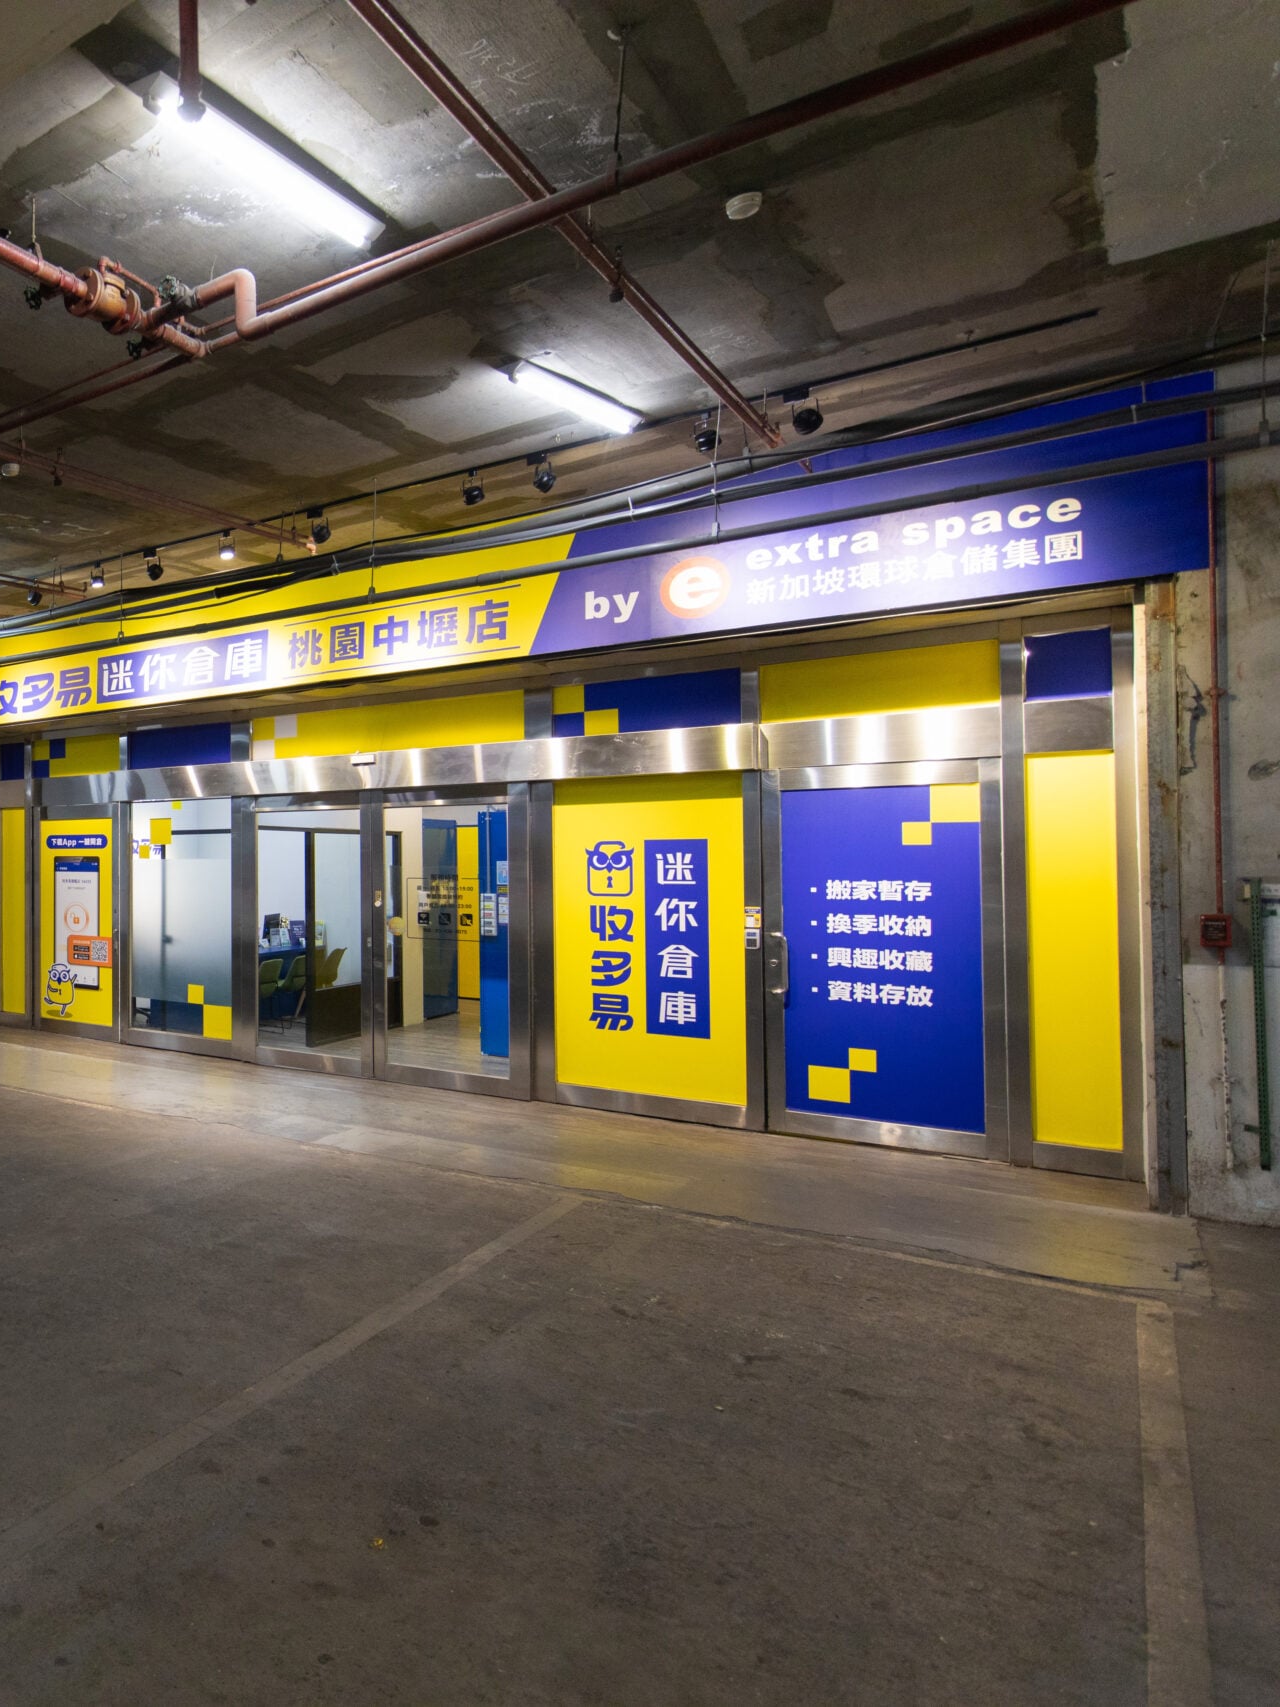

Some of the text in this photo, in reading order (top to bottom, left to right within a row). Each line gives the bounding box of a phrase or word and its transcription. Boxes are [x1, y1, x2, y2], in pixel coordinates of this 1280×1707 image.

[746, 498, 1082, 571] extra space
[745, 530, 1083, 604] 新加坡環球倉儲集團
[584, 591, 640, 623] by
[102, 638, 263, 697] 迷你倉庫
[287, 599, 510, 669] 桃園中壢店
[826, 880, 932, 901] 搬家暫存
[654, 852, 699, 1024] 迷你倉庫
[827, 913, 932, 937] 換季收納
[589, 905, 634, 1031] 收多易
[827, 947, 933, 973] 興趣收藏
[828, 980, 933, 1007] 資料存放
